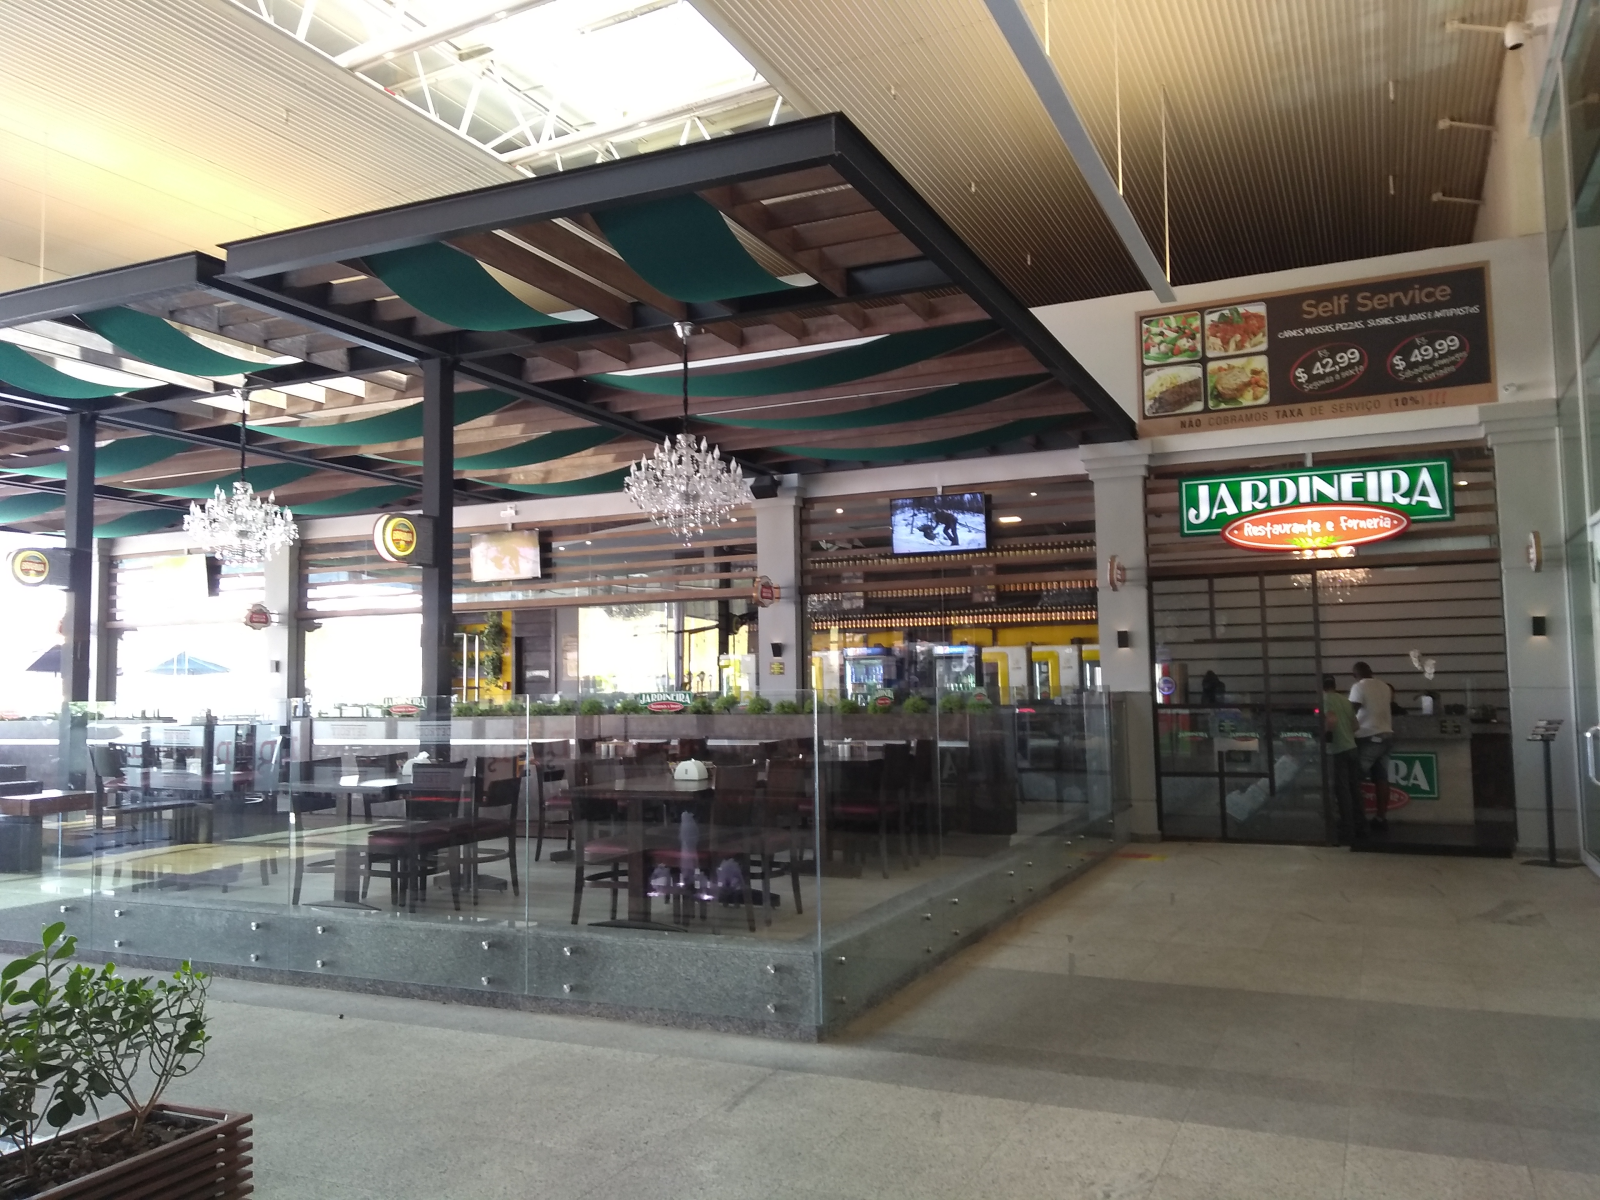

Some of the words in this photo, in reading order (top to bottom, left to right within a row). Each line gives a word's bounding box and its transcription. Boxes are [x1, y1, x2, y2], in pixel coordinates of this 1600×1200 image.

[1302, 293, 1349, 319] Self
[1356, 284, 1452, 313] Service
[1312, 348, 1361, 375] 42,99
[1409, 335, 1460, 363] 49,99
[1207, 411, 1269, 427] COBRAMOS
[1275, 407, 1304, 420] TAXA
[1310, 405, 1324, 416] DE
[1331, 399, 1381, 413] SERVIÇO
[1188, 466, 1443, 524] JARDINEIRA
[1243, 518, 1321, 540] Restaurante
[1326, 522, 1335, 532] e
[640, 693, 691, 705] JARDINEIRA
